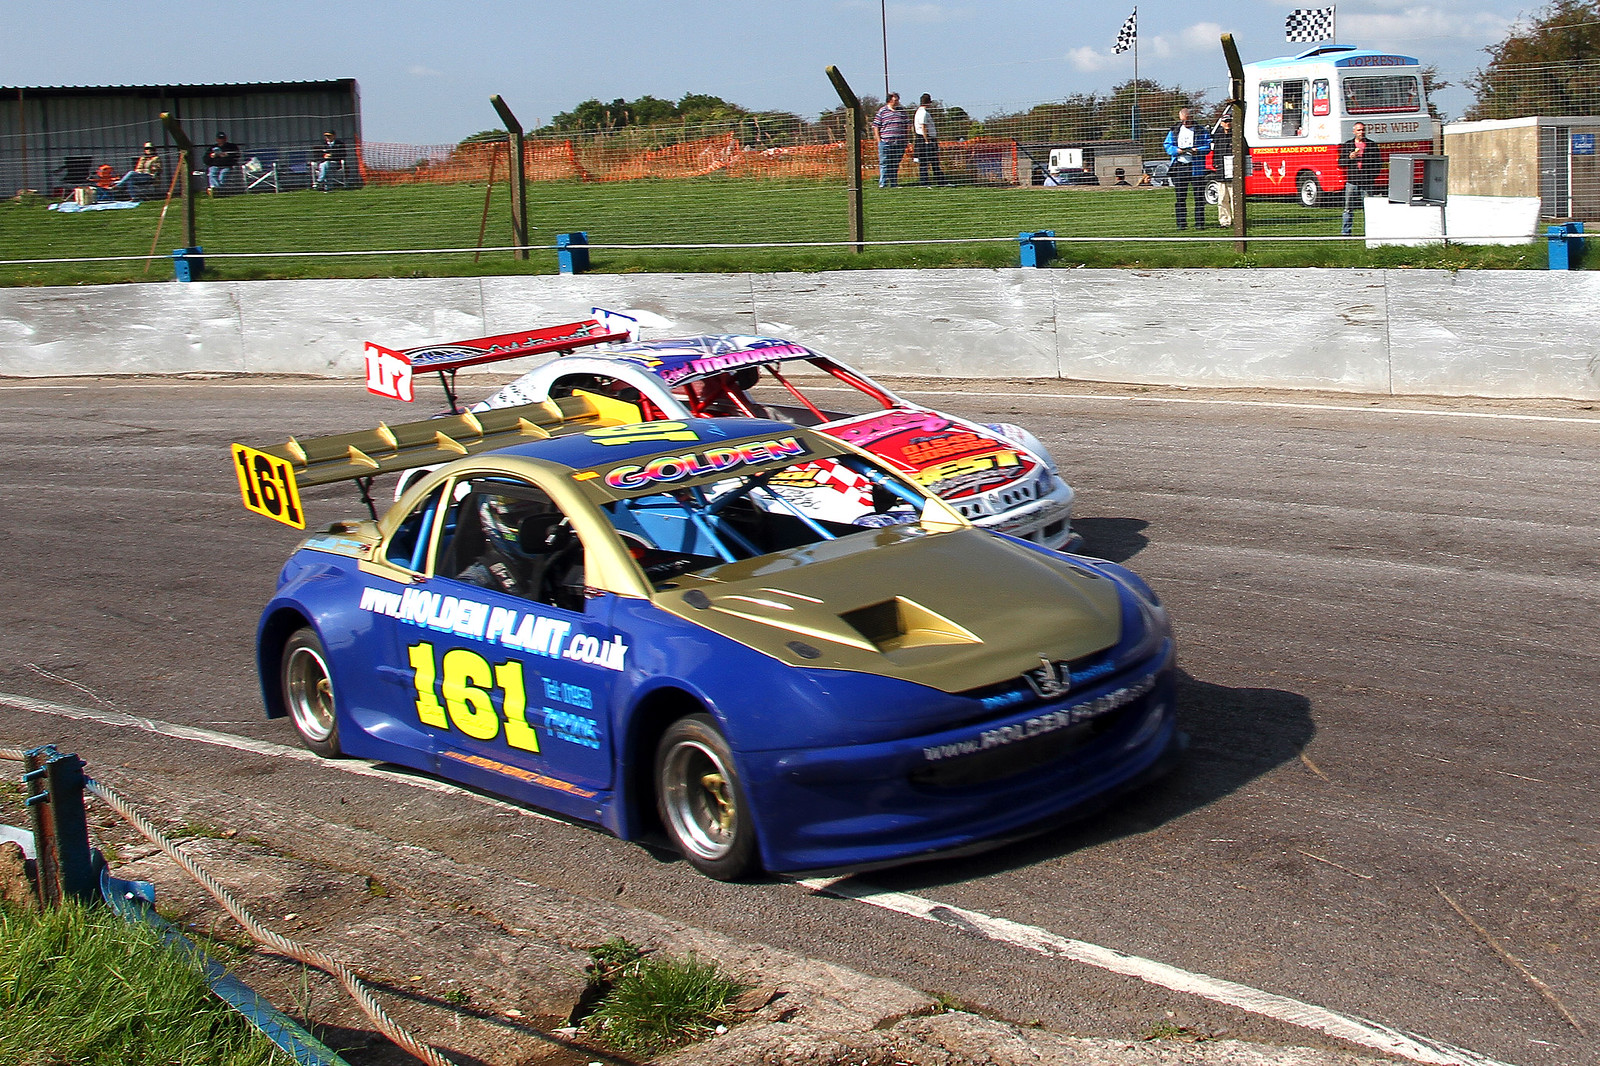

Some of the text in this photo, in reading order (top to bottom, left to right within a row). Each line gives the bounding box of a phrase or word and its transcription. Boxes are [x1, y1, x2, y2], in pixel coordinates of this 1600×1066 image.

[1348, 55, 1406, 67] LOPRESTI
[1365, 121, 1420, 134] PER WHIP
[237, 450, 302, 524] 161
[604, 437, 806, 489] GOLDEN
[485, 605, 572, 658] PLANT
[408, 641, 541, 753] 161
